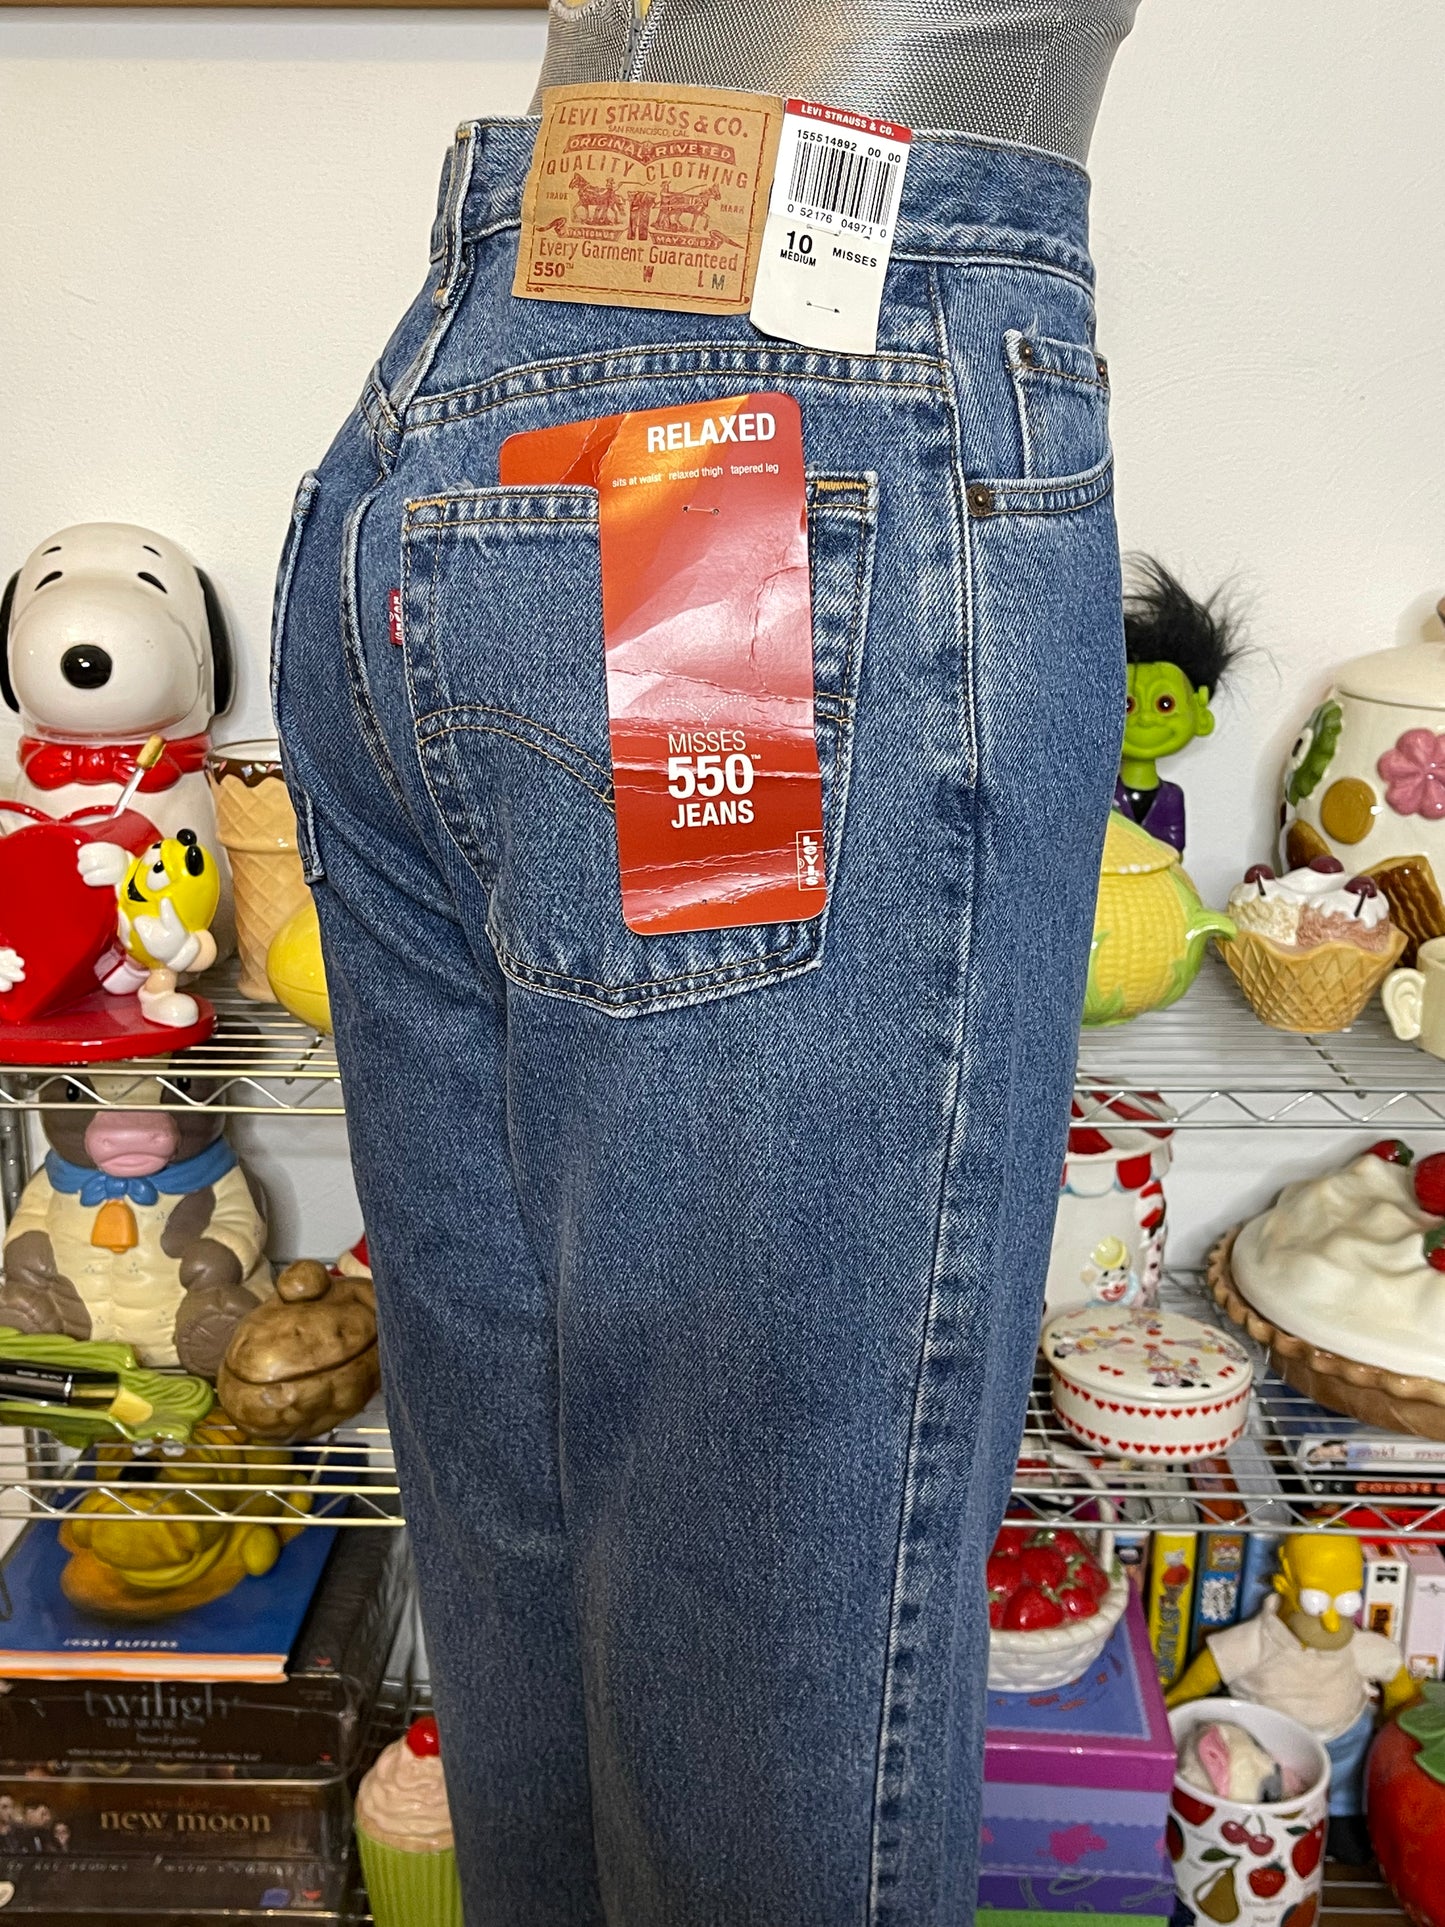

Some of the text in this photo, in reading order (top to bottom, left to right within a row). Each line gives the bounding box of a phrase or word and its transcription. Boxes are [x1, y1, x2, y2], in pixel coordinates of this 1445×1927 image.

[558, 103, 748, 138] LEVI STRAUSS & CO.
[608, 125, 624, 133] SAN
[801, 104, 895, 136] LEVI STRAUSS & CO.
[569, 135, 731, 159] ORIGINAL RIVETED
[797, 129, 901, 163] 155514892 00 00
[546, 154, 748, 189] QUALITY CLOTHING
[546, 192, 568, 200] TRADE
[720, 203, 745, 214] MARK
[787, 204, 887, 238] 0 52176 04971 0
[656, 236, 679, 244] MAY
[787, 231, 813, 254] 10
[540, 237, 738, 271] Every Garment Guaranteed
[780, 249, 817, 266] MEDIUM
[833, 247, 877, 267] MISSES
[643, 266, 654, 283] W
[698, 270, 704, 288] L
[711, 274, 725, 290] M
[647, 413, 776, 453] RELAXED
[612, 462, 779, 487] sits at waist relaxed thigh tapered leg
[668, 730, 746, 753] MISSES
[671, 799, 755, 829] JEANS
[100, 1809, 271, 1833] new moon
